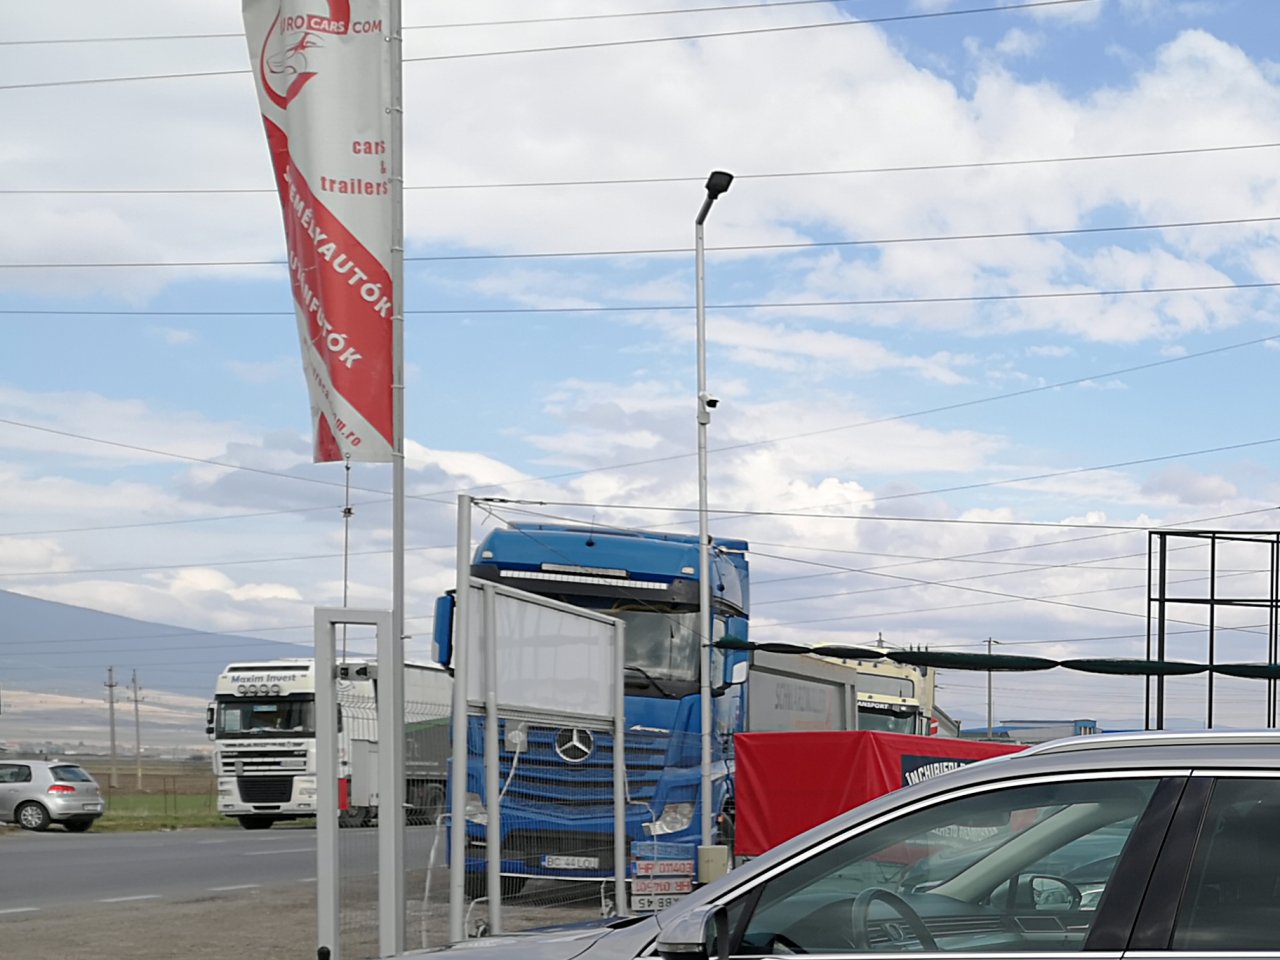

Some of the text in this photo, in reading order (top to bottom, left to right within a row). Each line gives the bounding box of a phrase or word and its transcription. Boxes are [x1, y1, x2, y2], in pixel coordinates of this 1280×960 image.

[309, 17, 346, 33] CARS
[352, 140, 386, 155] cars
[320, 175, 389, 196] trailers
[231, 674, 297, 683] Maxim Invest
